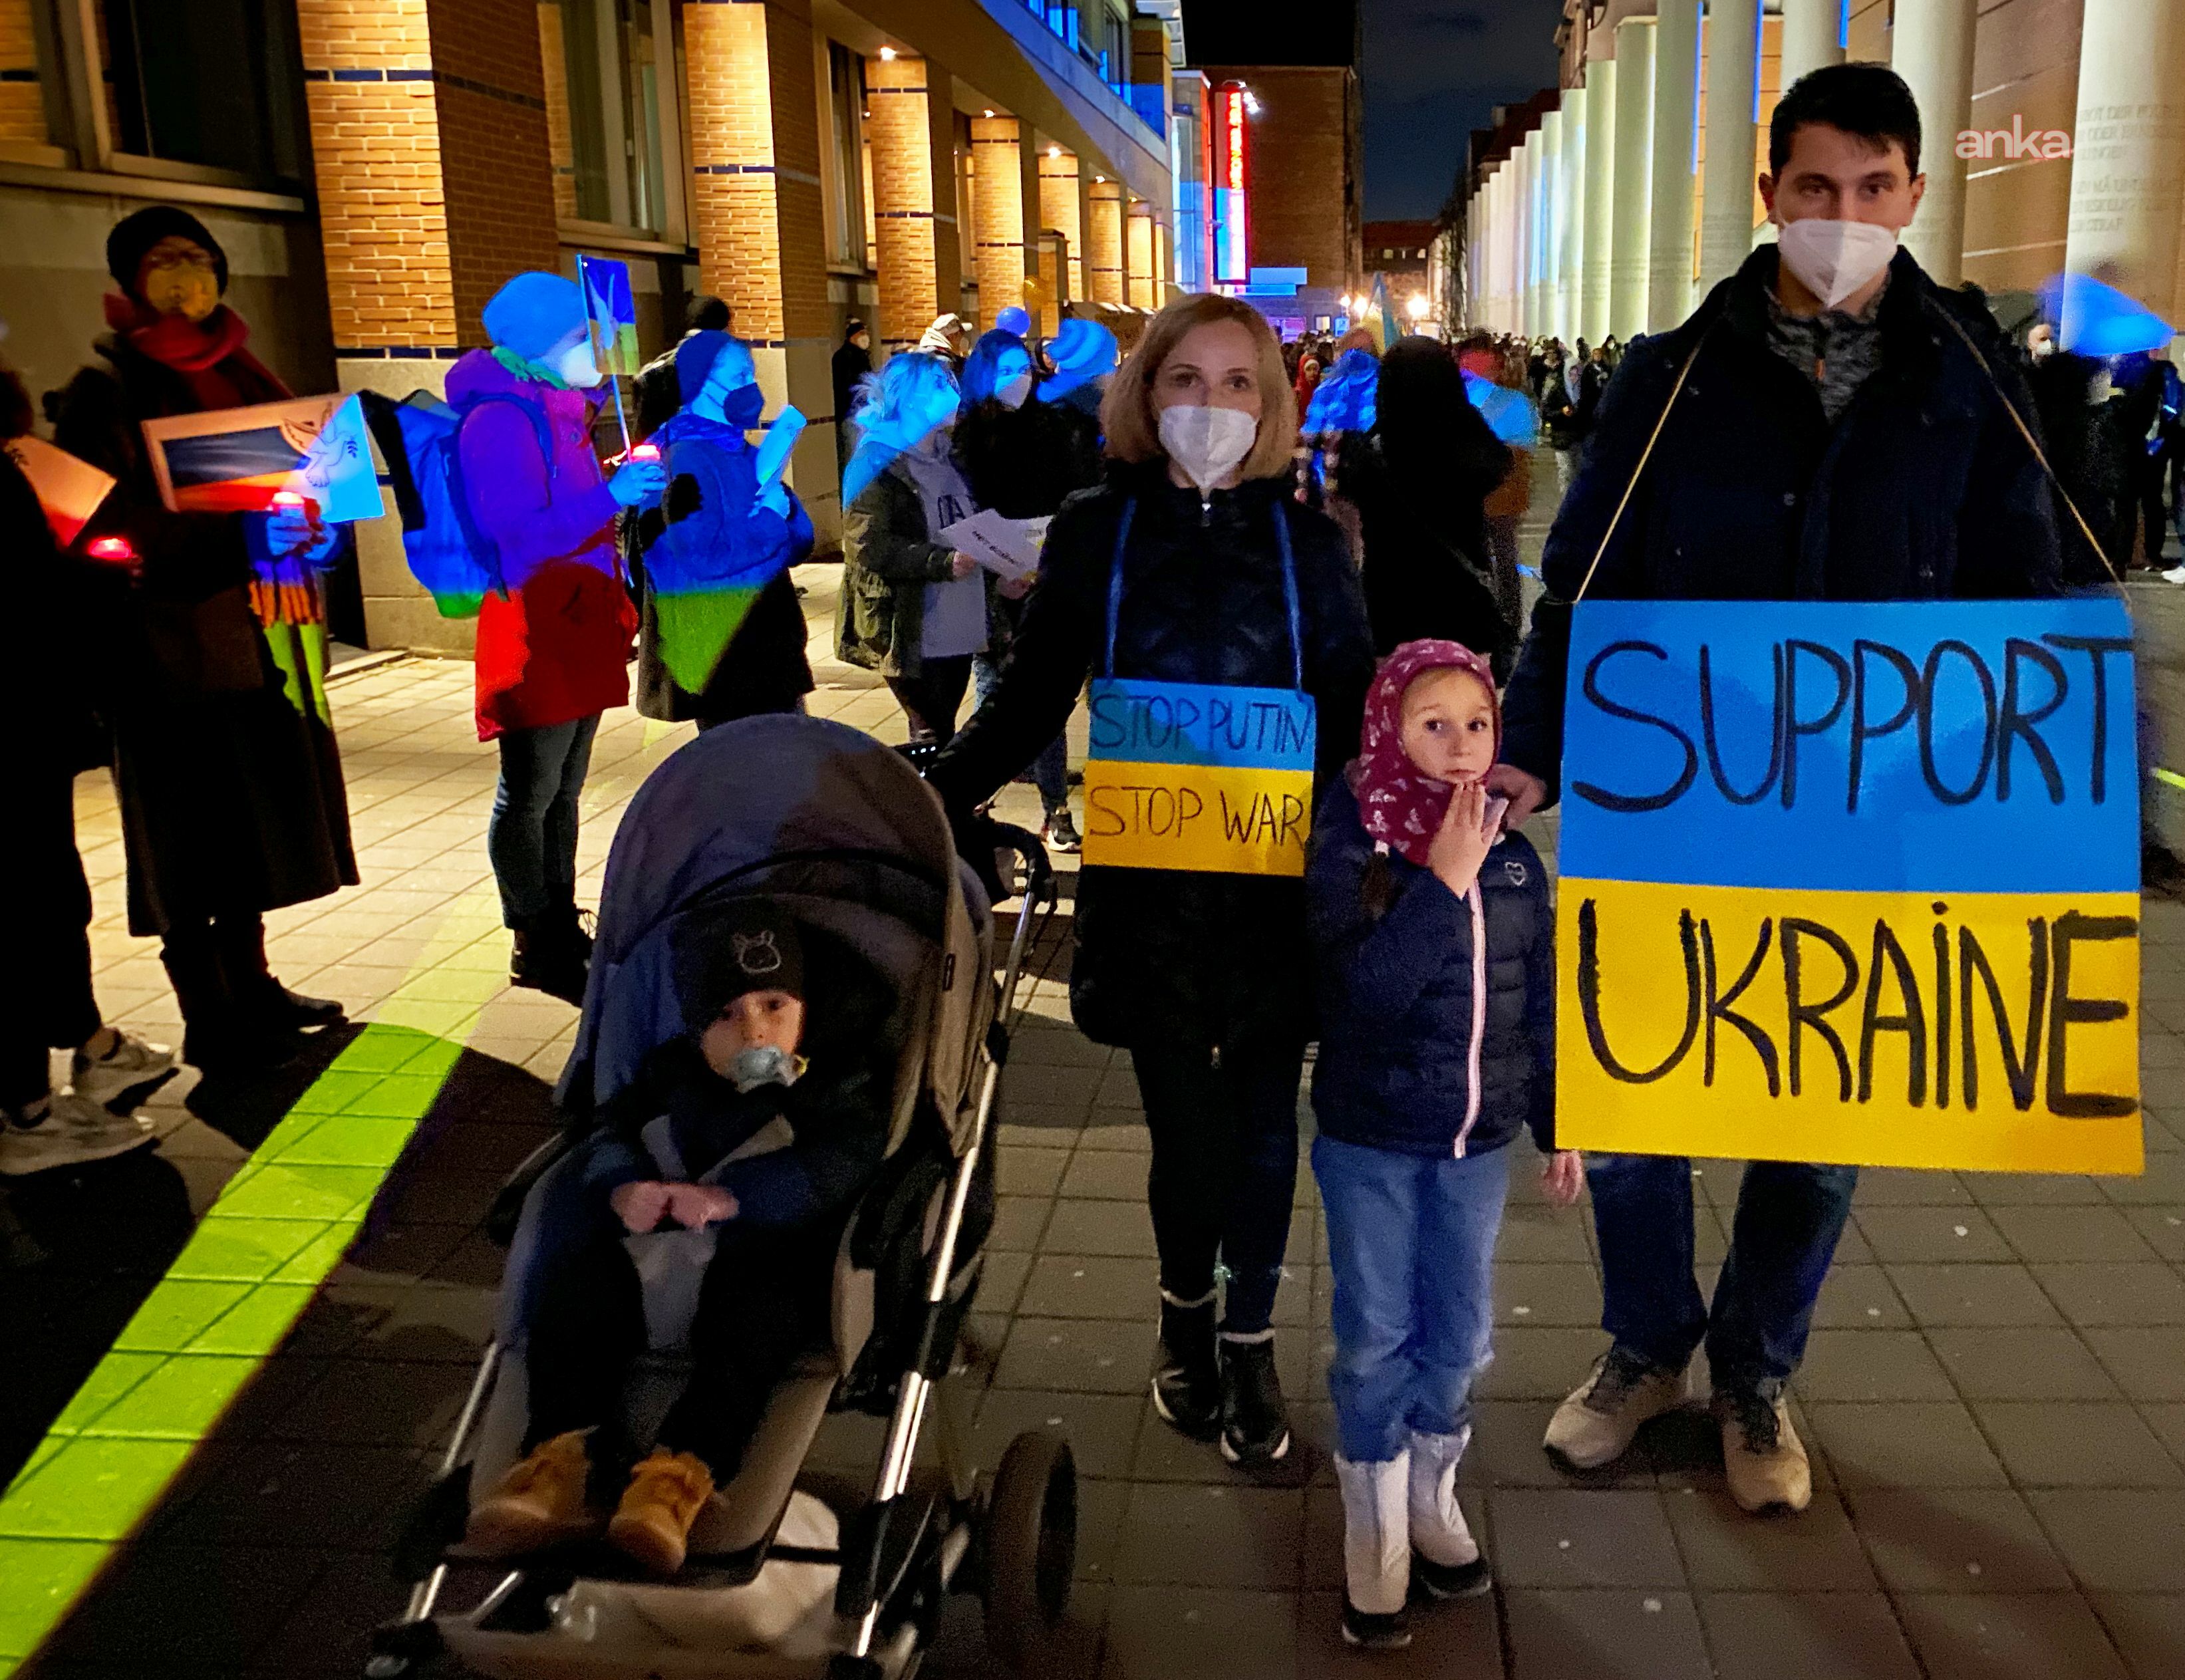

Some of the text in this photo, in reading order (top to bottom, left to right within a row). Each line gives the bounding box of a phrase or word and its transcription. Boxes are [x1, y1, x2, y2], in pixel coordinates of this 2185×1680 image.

[1090, 694, 1313, 754] STOP PUTIN
[1571, 633, 2134, 815] SUPPORT
[1089, 785, 1305, 851] STOP WAR
